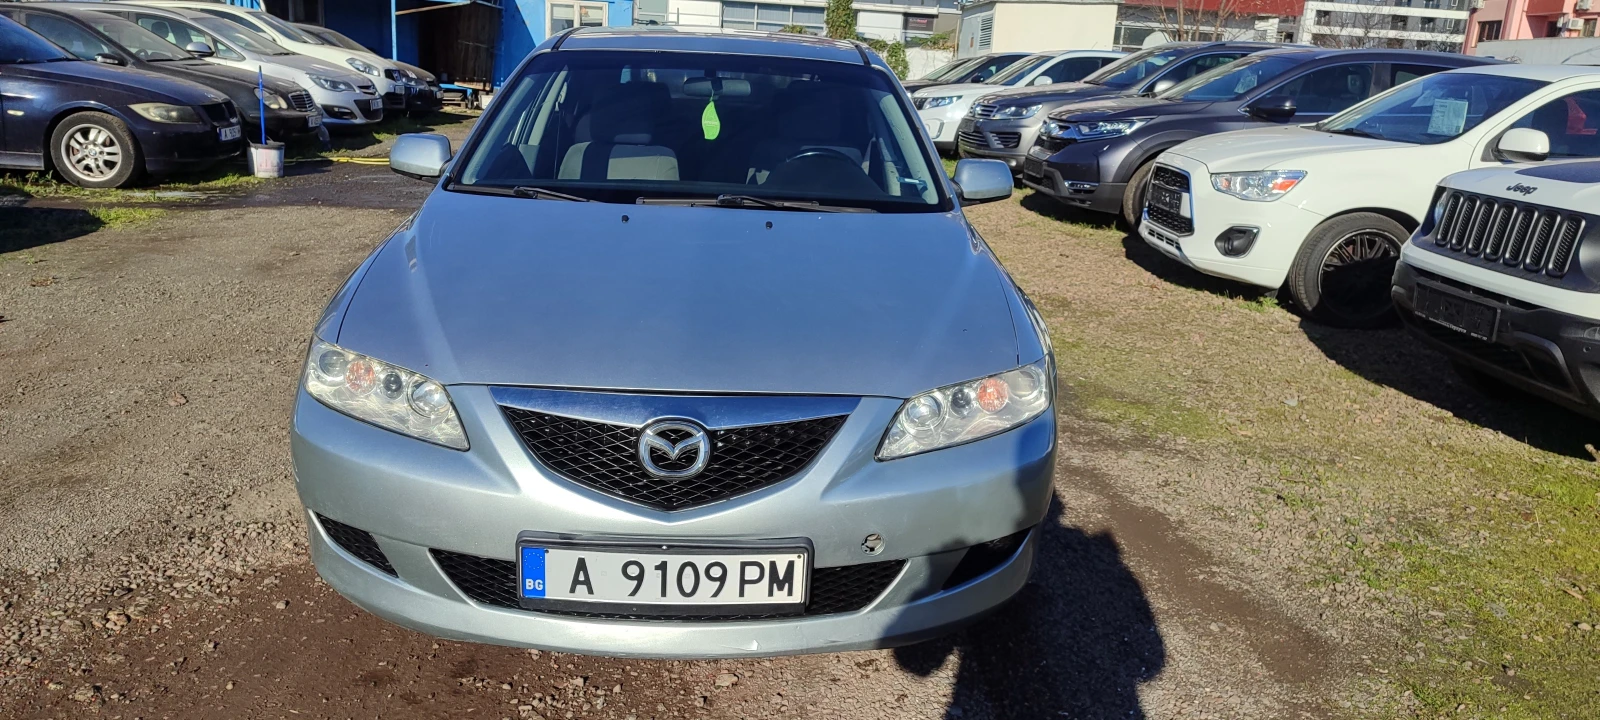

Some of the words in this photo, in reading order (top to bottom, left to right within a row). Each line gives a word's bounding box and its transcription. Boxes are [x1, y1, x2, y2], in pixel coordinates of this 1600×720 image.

[1505, 182, 1538, 196] Jeep
[568, 556, 595, 596] A
[524, 578, 544, 591] BG
